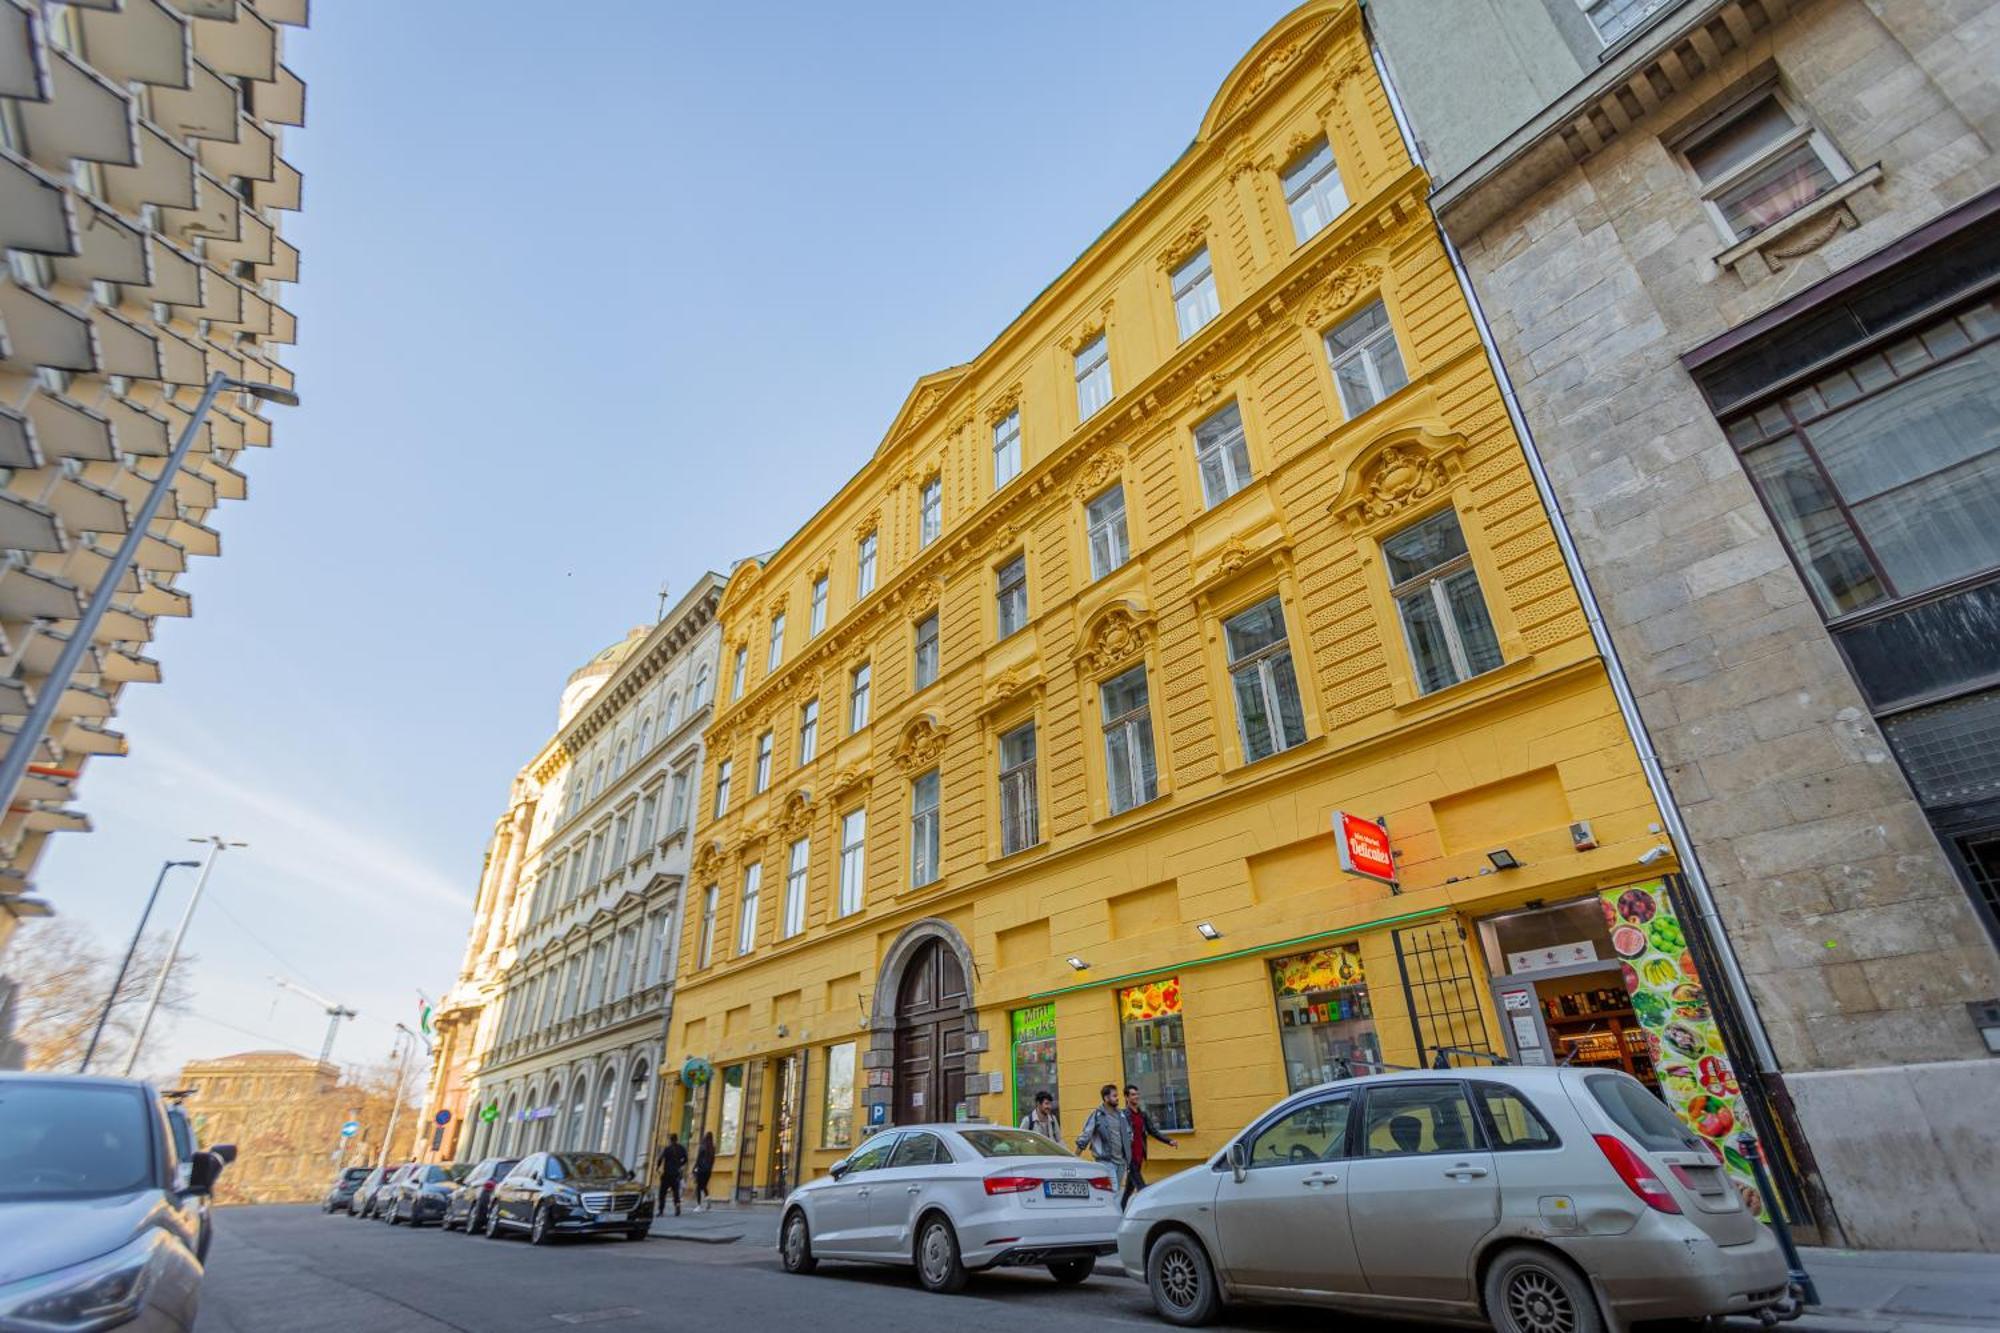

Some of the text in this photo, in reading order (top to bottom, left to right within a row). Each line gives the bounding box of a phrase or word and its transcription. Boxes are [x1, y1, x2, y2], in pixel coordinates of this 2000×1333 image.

[1024, 1005, 1049, 1025] Mini
[1017, 1018, 1056, 1041] Marke
[873, 1105, 884, 1120] P
